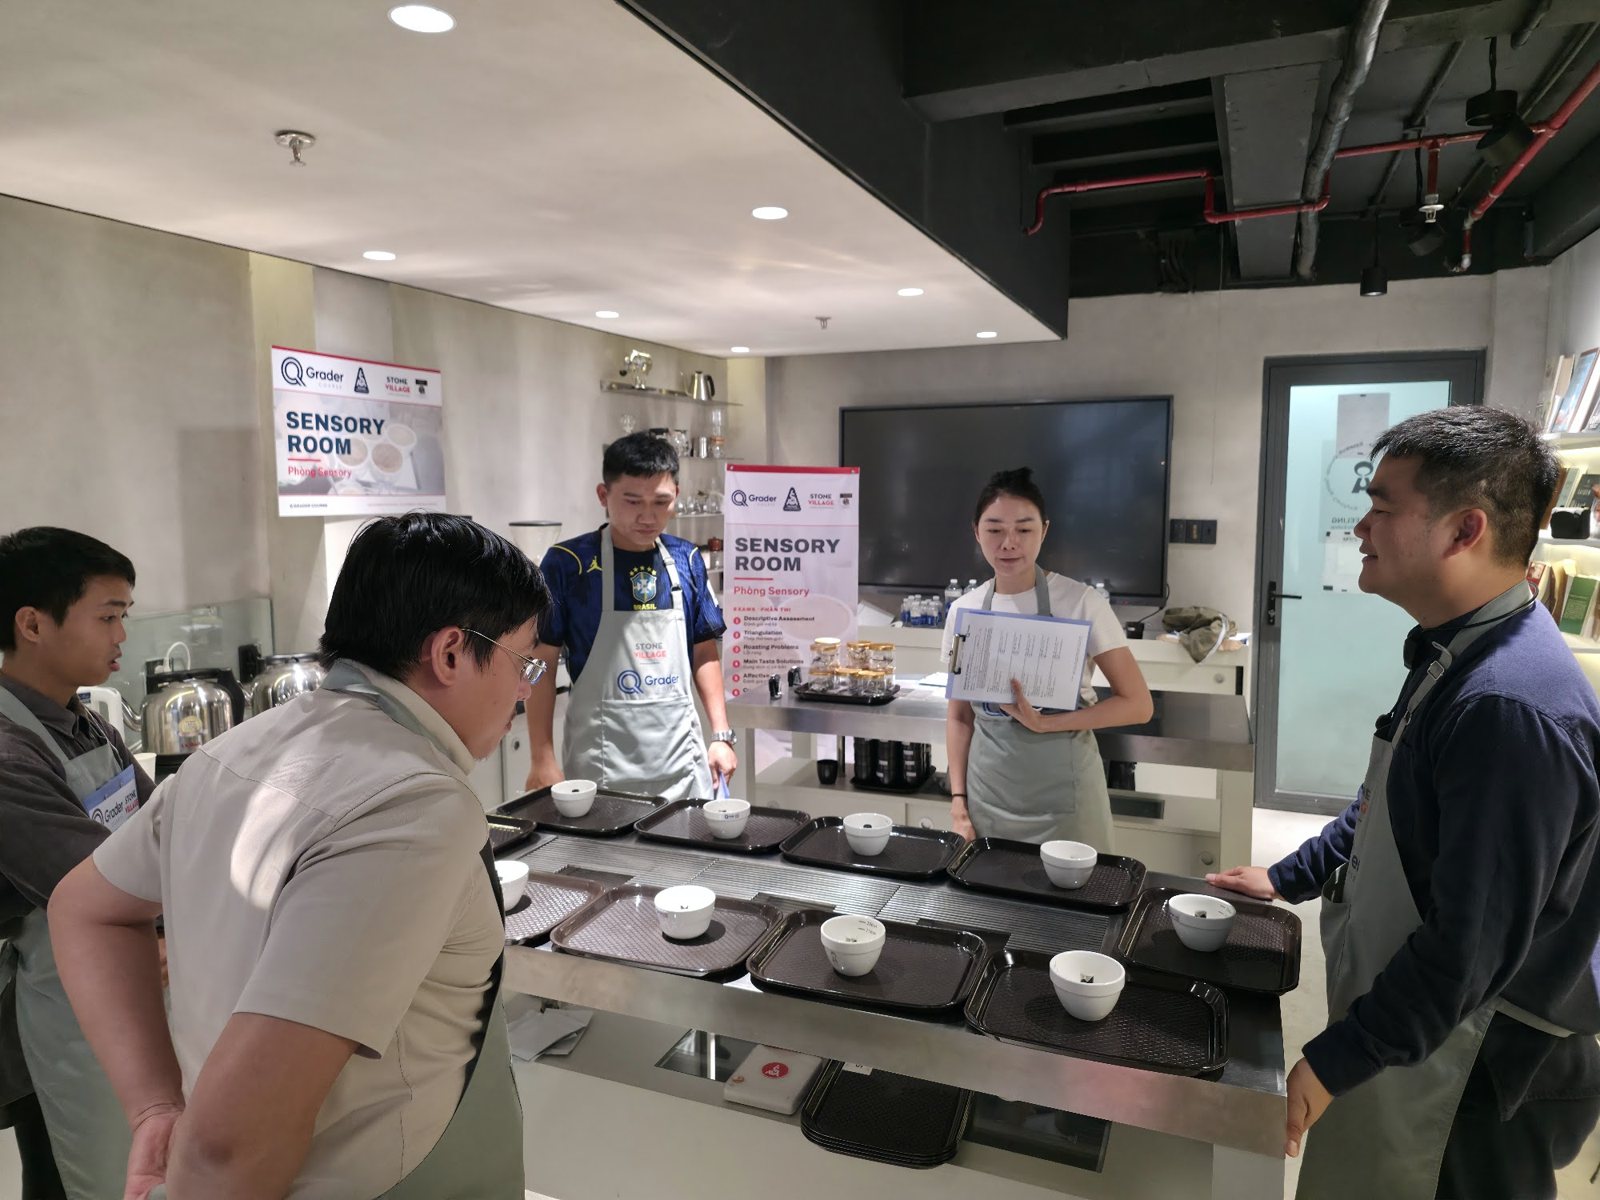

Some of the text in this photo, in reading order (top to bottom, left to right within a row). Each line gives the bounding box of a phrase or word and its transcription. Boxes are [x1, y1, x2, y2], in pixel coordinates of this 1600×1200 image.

[281, 356, 344, 387] Q Grader
[385, 384, 411, 393] VILLAGE
[386, 376, 408, 385] STONE
[286, 410, 385, 435] SENSORY
[287, 434, 352, 456] ROOM
[287, 465, 352, 480] Phòng Sensory
[731, 489, 777, 507] Q Grader
[735, 537, 840, 553] SENSORY
[735, 556, 801, 572] ROOM
[733, 585, 810, 597] Phòng Sensory
[633, 650, 667, 658] VILLAGE
[617, 669, 679, 694] Q Grader
[104, 801, 123, 823] Grader
